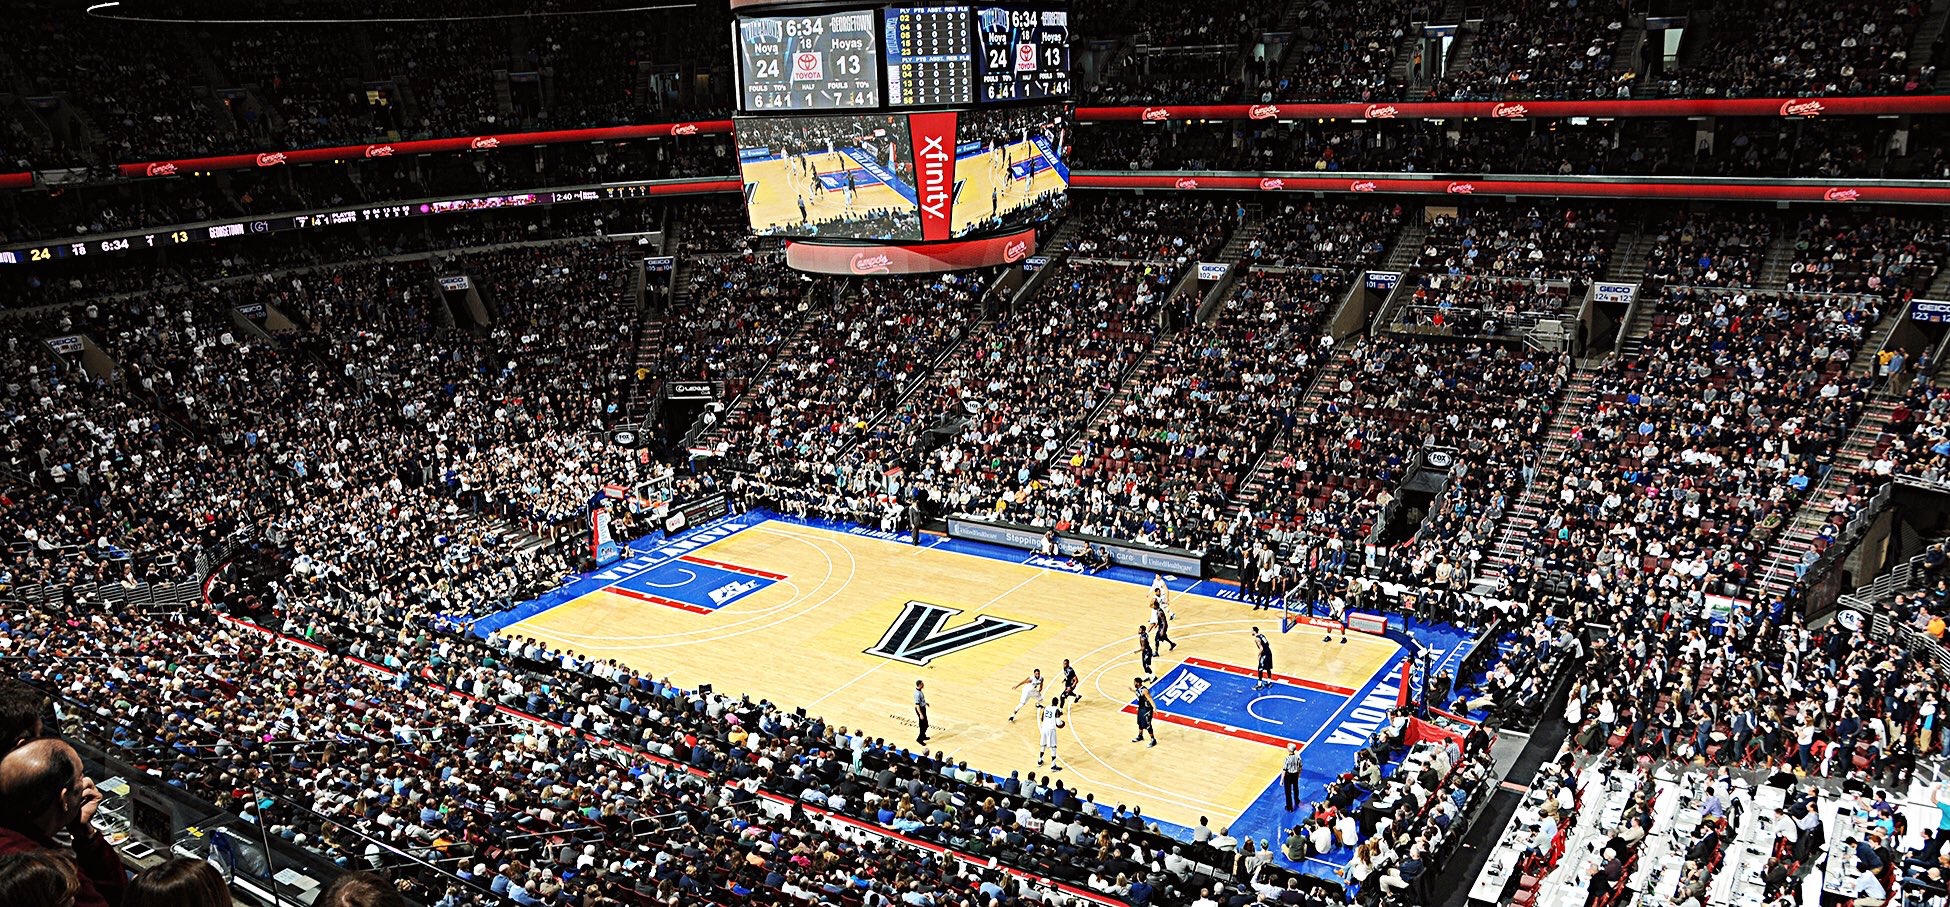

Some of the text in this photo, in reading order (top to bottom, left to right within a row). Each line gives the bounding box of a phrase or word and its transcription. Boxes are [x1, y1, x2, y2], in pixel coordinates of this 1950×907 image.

[786, 18, 823, 36] 6:34
[831, 15, 872, 33] GEORGETOWN
[1012, 11, 1037, 28] 6:34
[989, 32, 1007, 42] Nova
[1022, 30, 1030, 40] 18
[1042, 32, 1062, 43] Hoyas
[754, 43, 779, 53] Nova
[800, 38, 812, 49] 18
[832, 38, 863, 50] Hoyas
[901, 48, 911, 56] 23
[990, 49, 1007, 68] 24
[1045, 48, 1060, 66] 13
[756, 59, 780, 78] 24
[837, 55, 860, 75] 13
[988, 84, 1015, 99] 6 4 1
[1024, 83, 1030, 96] 1
[1043, 81, 1068, 95] 7 4 1
[754, 94, 792, 108] 6 4 1
[805, 93, 812, 107] 1
[834, 91, 874, 106] 7 4 1
[556, 192, 572, 201] 2:40
[332, 211, 356, 219] PLAYER
[171, 231, 188, 243] 13
[208, 223, 244, 239] GEORGETOWN
[72, 246, 86, 256] 18
[101, 238, 129, 251] 6:34
[30, 248, 51, 261] 24
[1600, 286, 1630, 294] GEICO
[1912, 312, 1929, 321] 123
[50, 337, 78, 346] GEICO
[1432, 453, 1446, 462] FOX
[1006, 533, 1042, 547] Stepping
[592, 523, 748, 580] VILLANOVA
[862, 600, 1038, 667] V
[1160, 671, 1200, 706] EAST
[1180, 677, 1211, 704] BIG
[1045, 709, 1053, 719] 23
